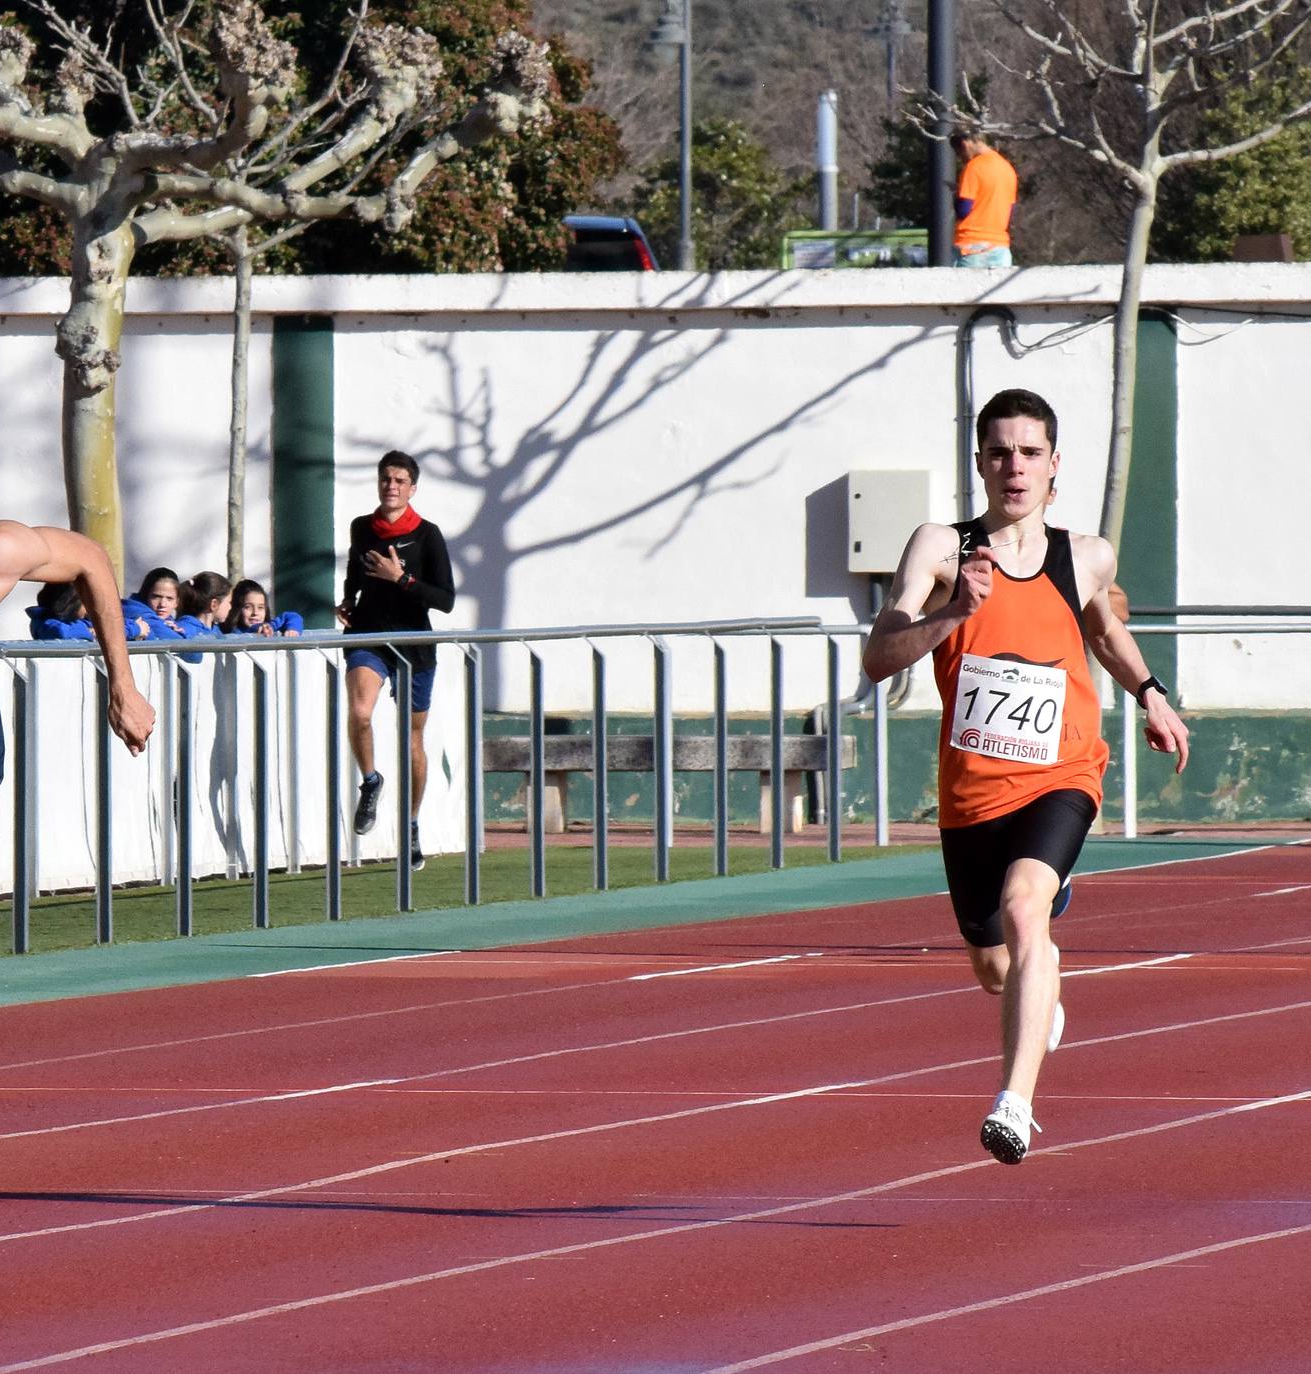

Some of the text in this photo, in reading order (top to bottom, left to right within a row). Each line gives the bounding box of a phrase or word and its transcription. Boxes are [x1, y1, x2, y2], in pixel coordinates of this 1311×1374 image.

[962, 663, 1064, 689] Gobierno de La Rioja
[963, 686, 1058, 734] 1740
[982, 738, 1049, 761] ATLETISMO
